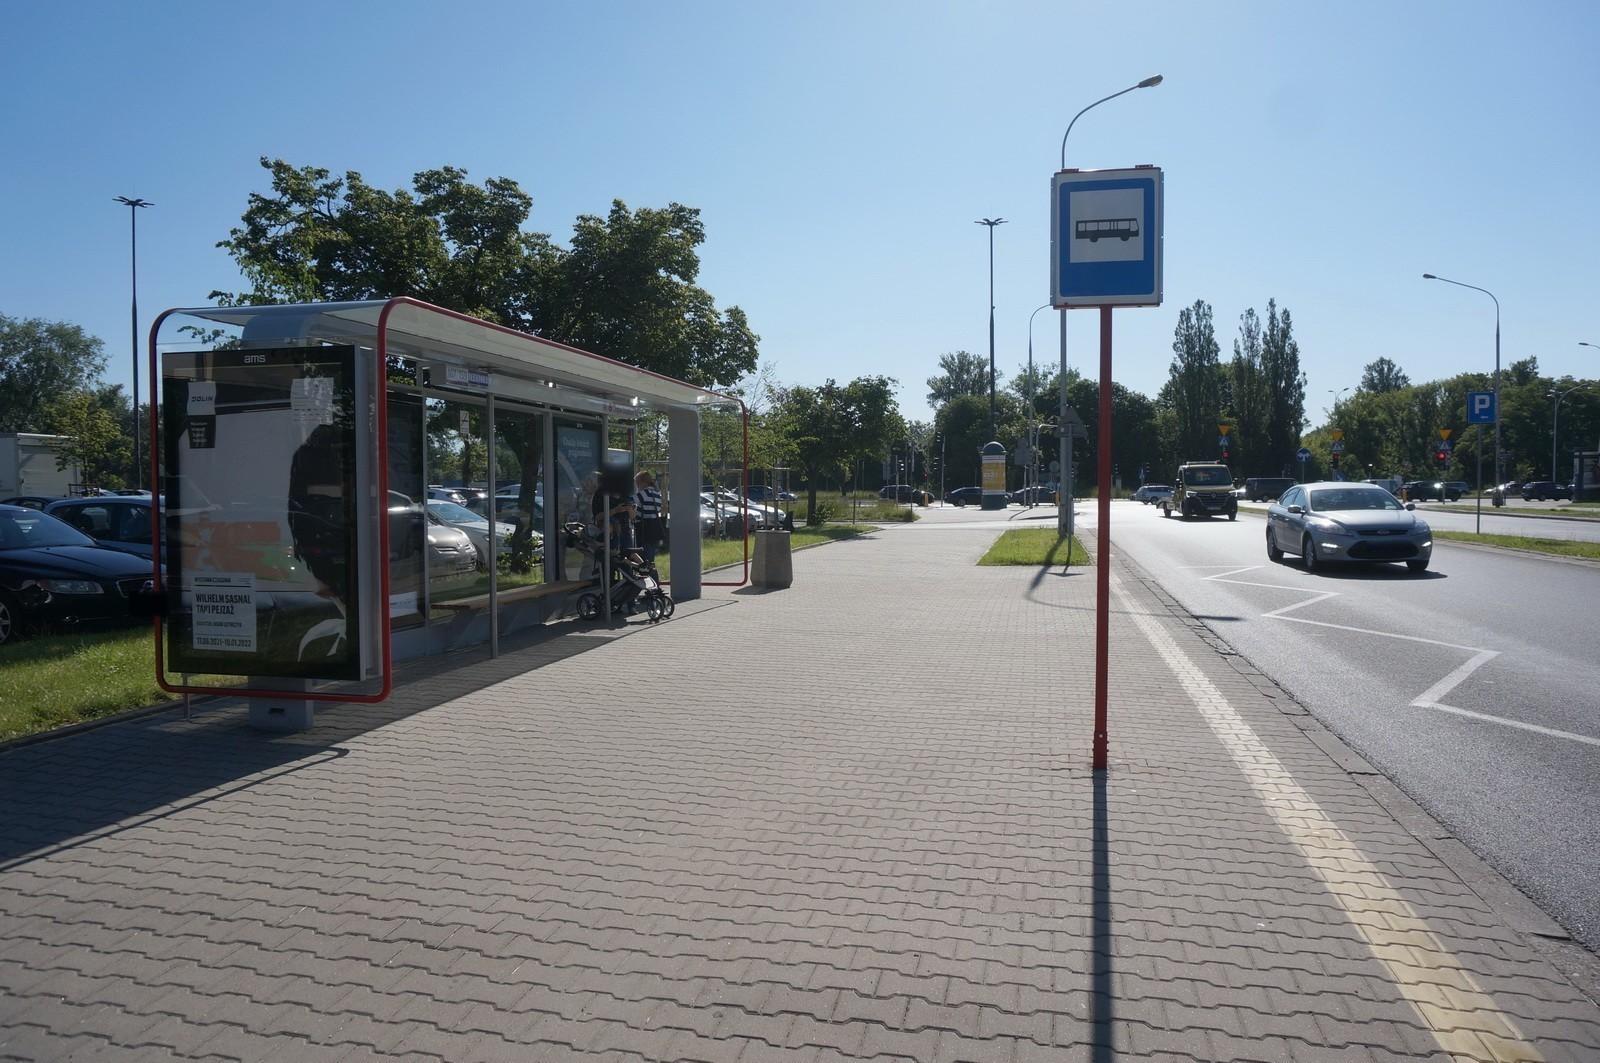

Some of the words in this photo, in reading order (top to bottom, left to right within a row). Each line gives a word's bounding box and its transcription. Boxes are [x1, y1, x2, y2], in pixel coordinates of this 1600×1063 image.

[244, 354, 266, 363] ams
[1474, 394, 1490, 414] P
[195, 593, 224, 603] WILHELM
[225, 594, 252, 604] SASNAL
